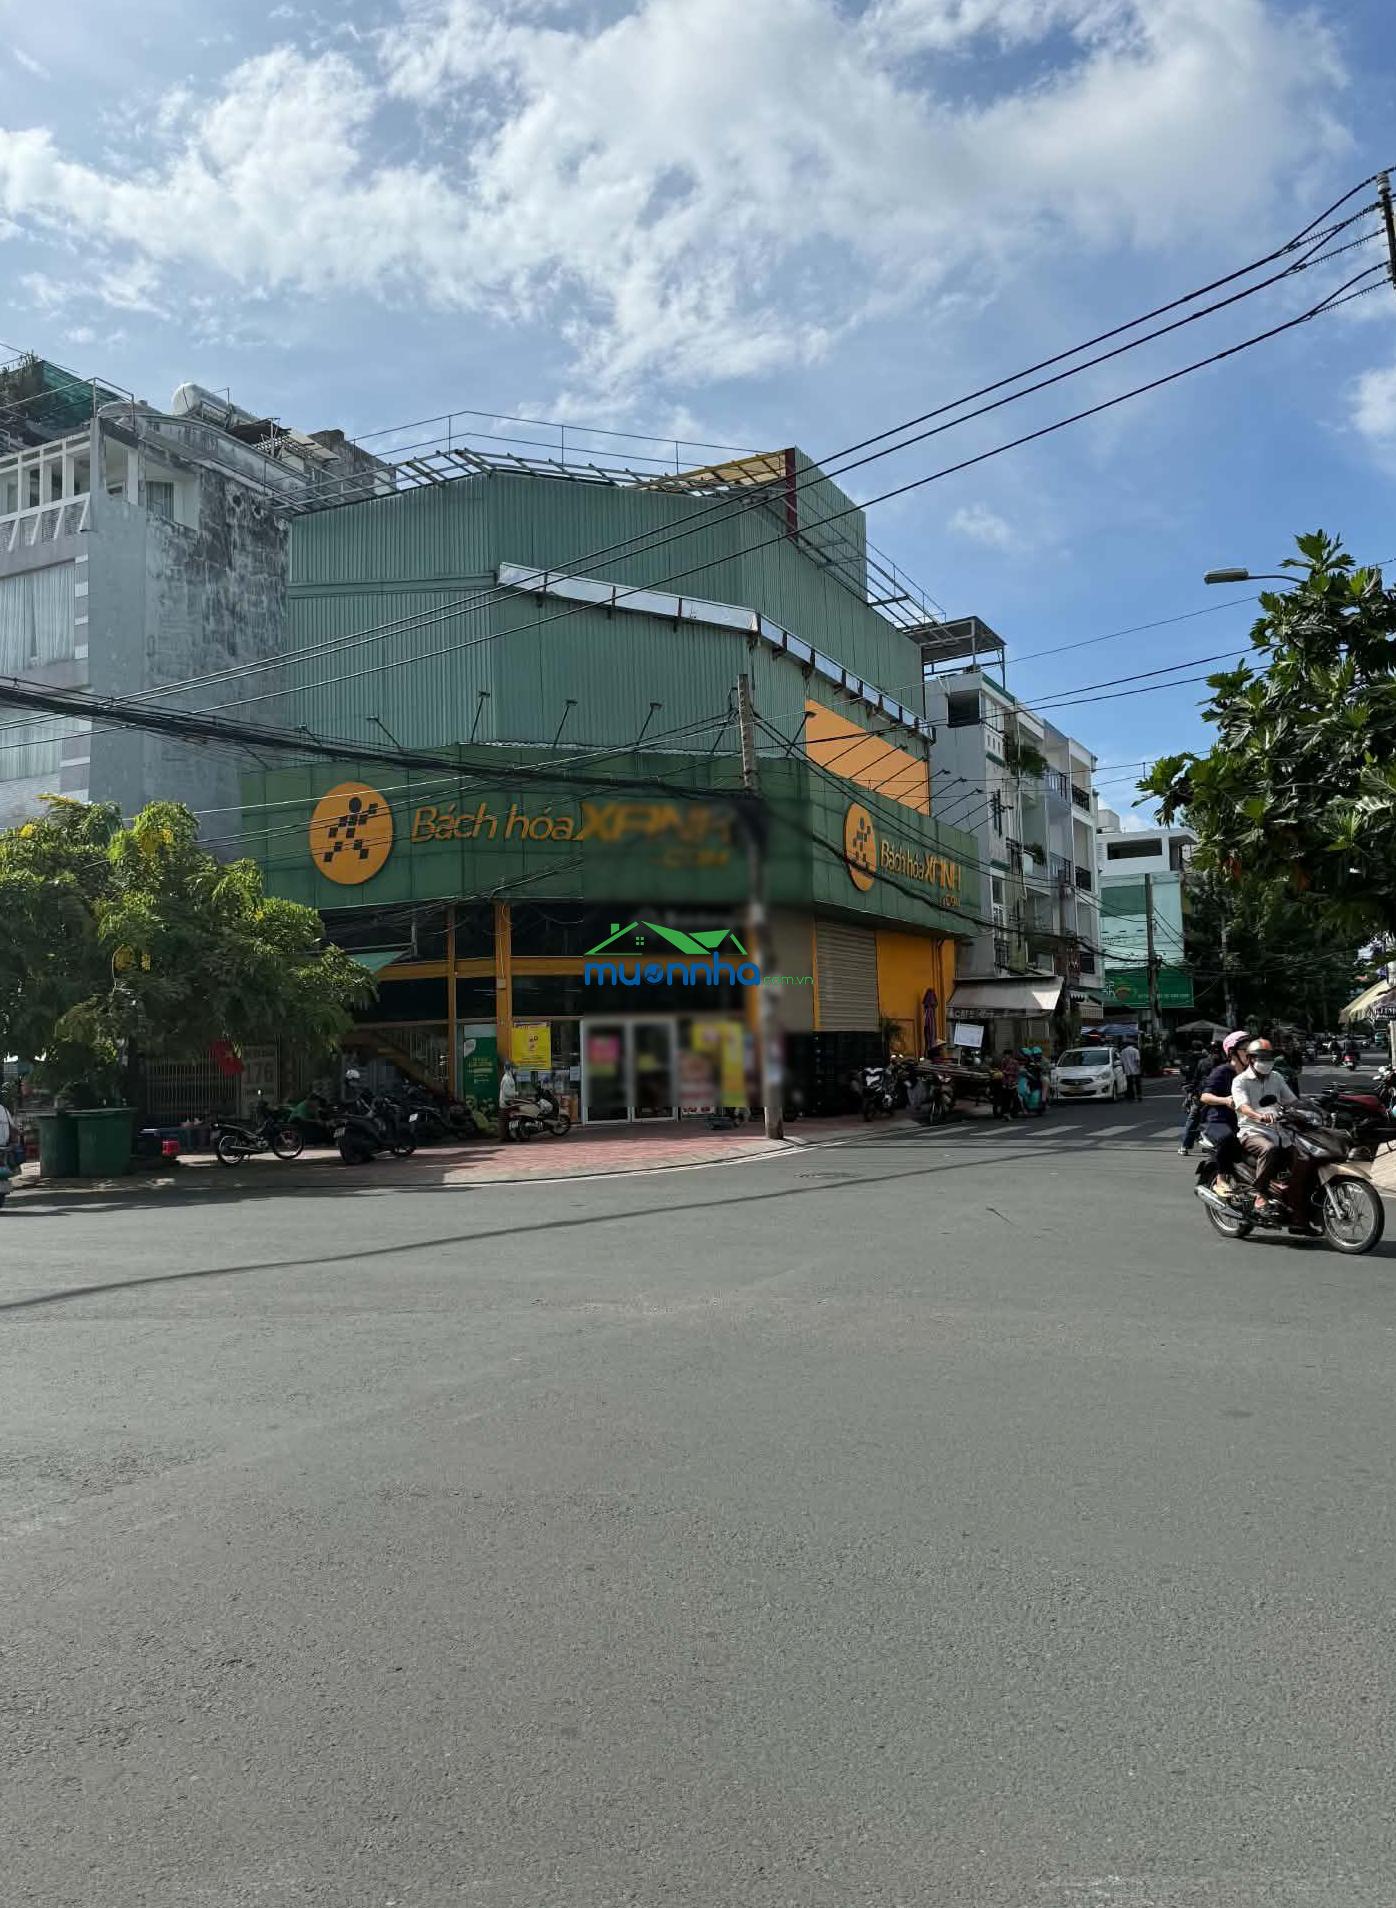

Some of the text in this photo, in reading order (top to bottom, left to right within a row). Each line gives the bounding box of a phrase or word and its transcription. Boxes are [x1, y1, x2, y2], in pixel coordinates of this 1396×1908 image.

[411, 802, 497, 843] Bách
[504, 803, 575, 841] hóa
[880, 838, 906, 874] Bách
[907, 848, 925, 881] hóa
